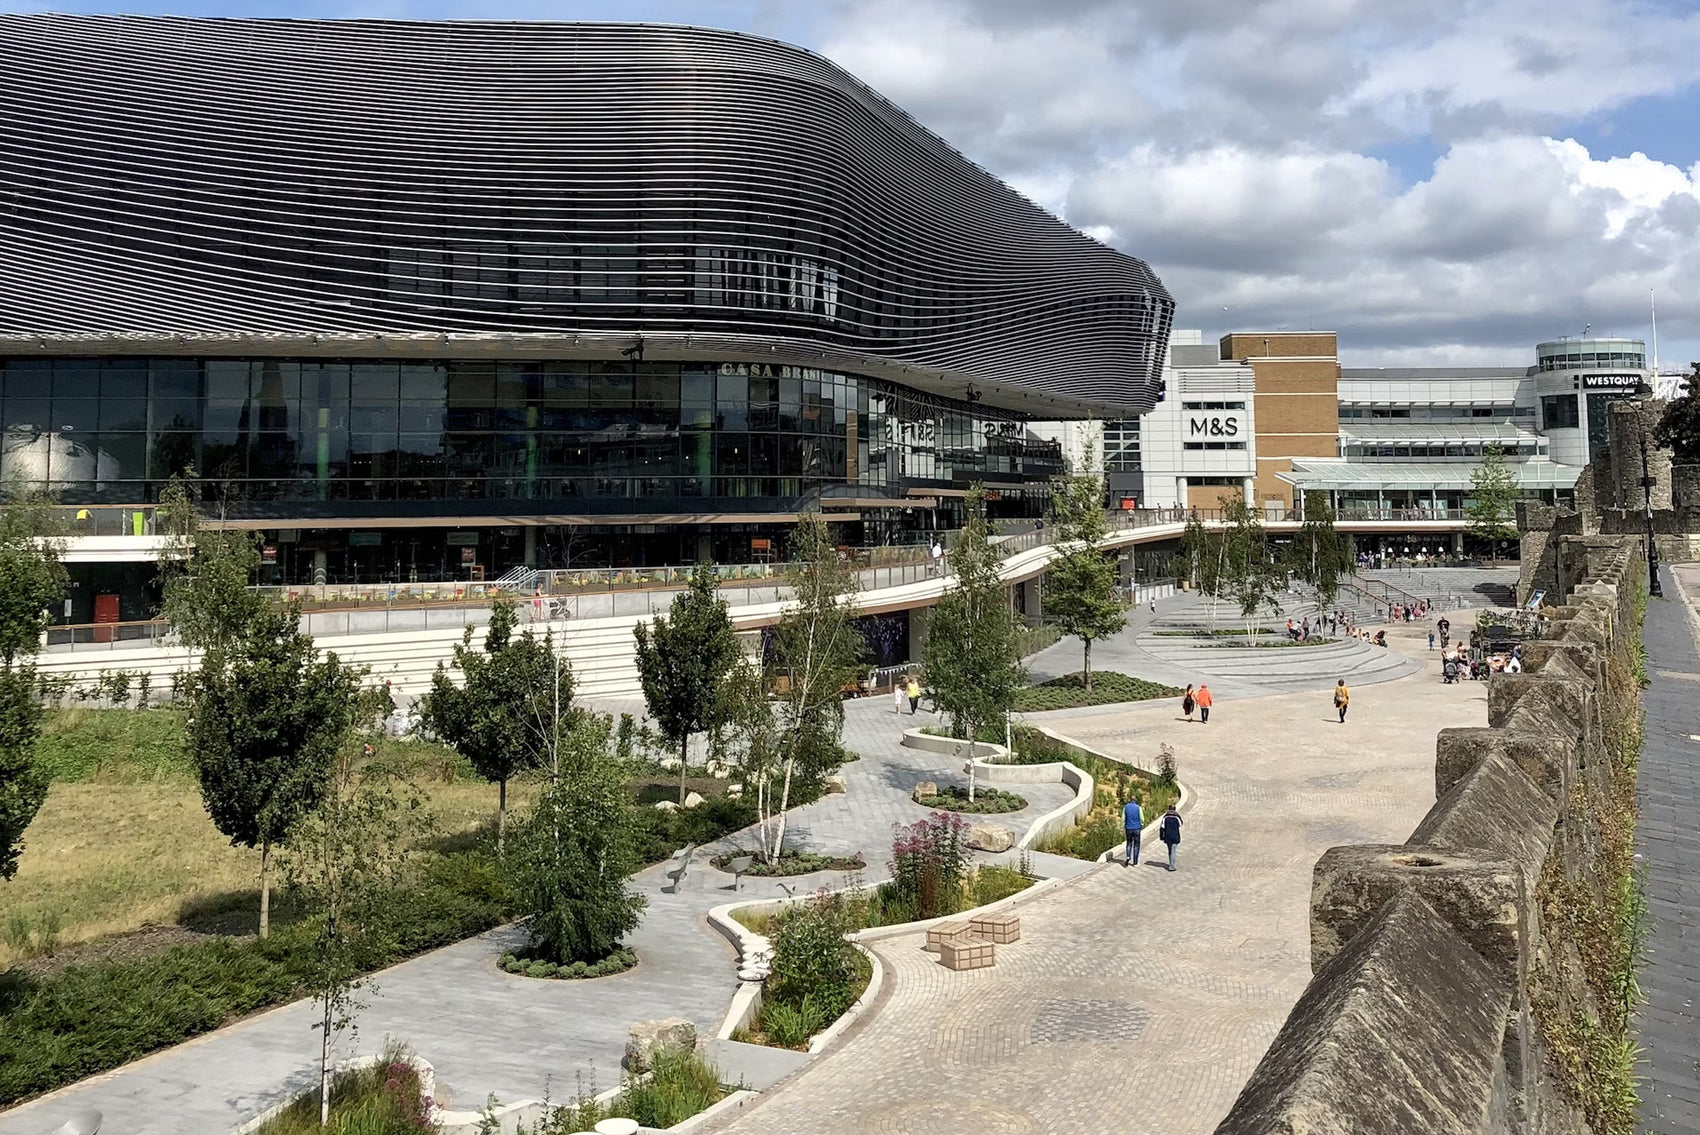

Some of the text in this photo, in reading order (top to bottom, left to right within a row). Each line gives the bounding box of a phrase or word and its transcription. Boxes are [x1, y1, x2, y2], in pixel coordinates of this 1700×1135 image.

[721, 363, 773, 377] CASA
[1586, 376, 1639, 385] WESTQUAY
[1190, 417, 1238, 437] M&S
